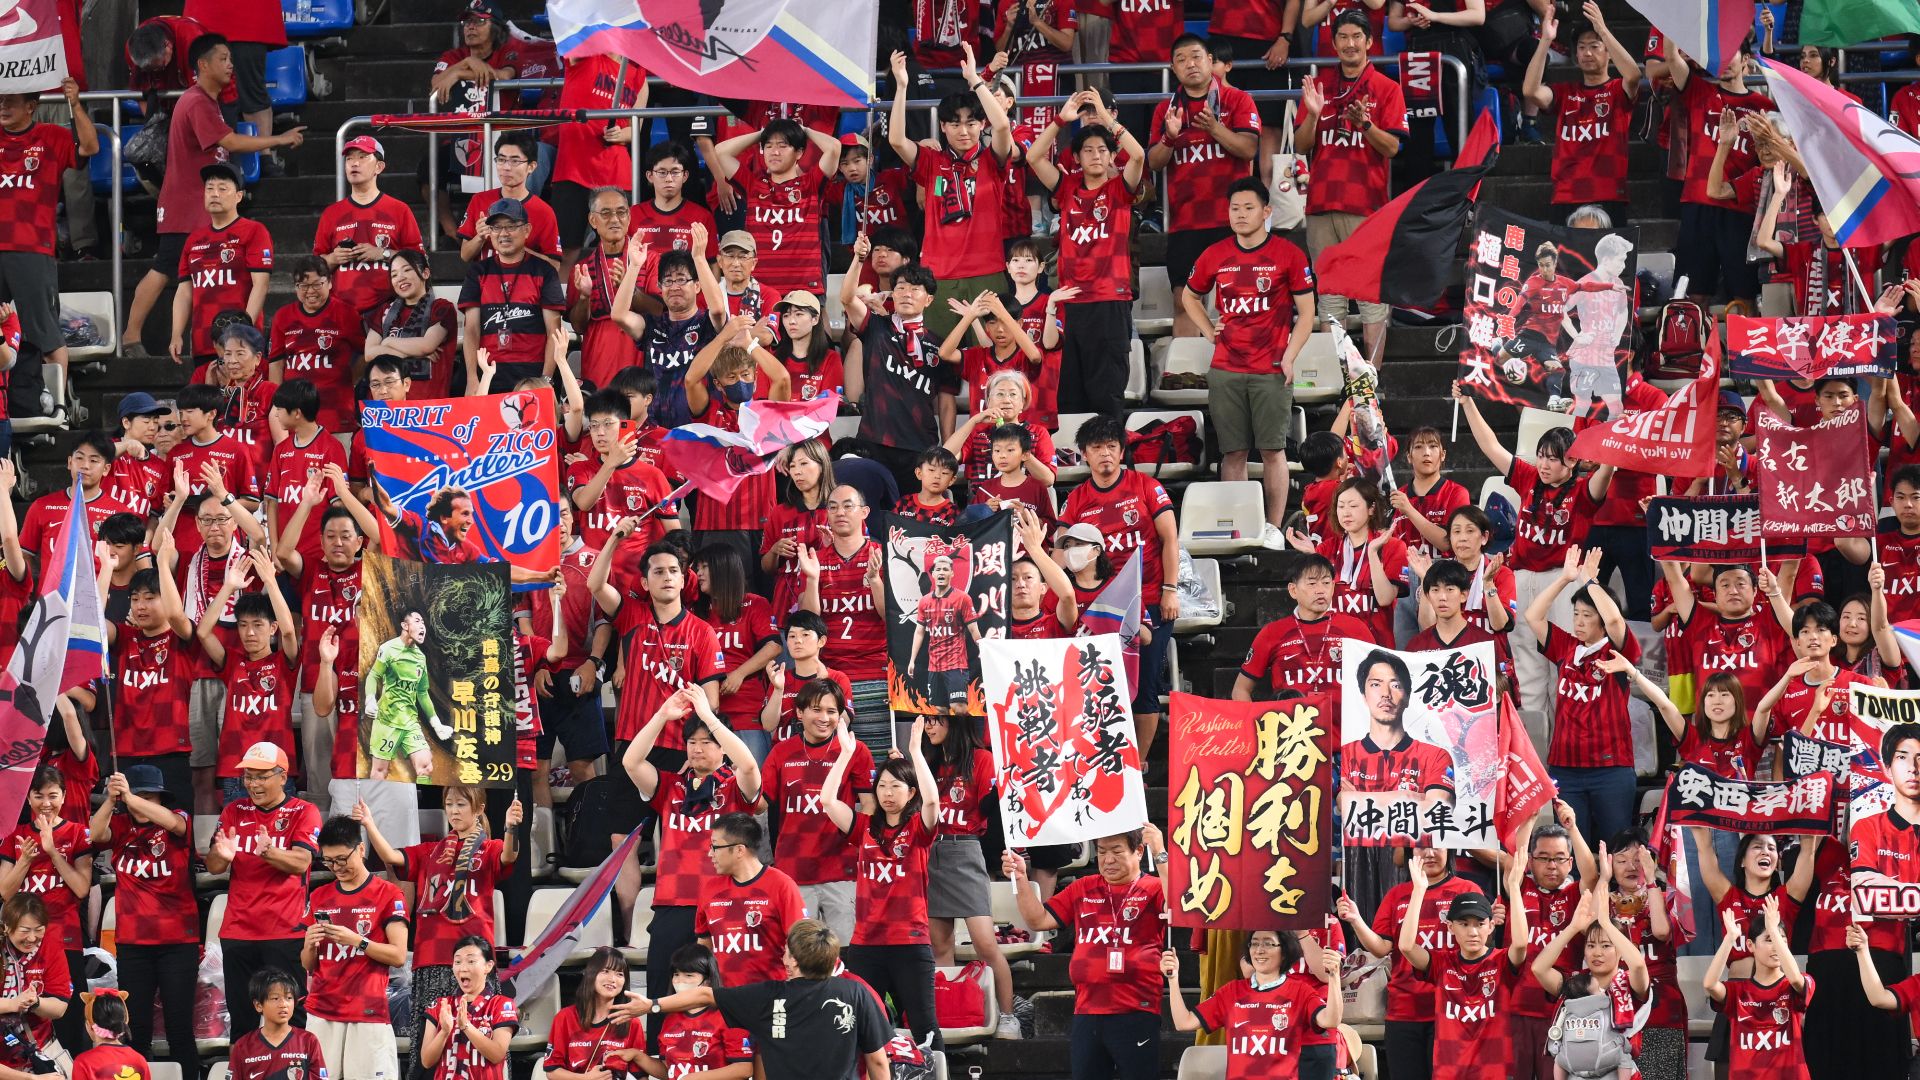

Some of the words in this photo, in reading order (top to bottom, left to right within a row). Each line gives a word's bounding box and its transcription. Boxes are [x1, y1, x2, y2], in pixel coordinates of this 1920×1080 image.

[1561, 122, 1610, 141] LIXIL
[1704, 122, 1749, 155] LIIL
[1174, 143, 1225, 164] LIXIL
[756, 205, 804, 224] LIXIL
[336, 222, 358, 232] mercari
[371, 222, 396, 230] mercari
[771, 229, 783, 251] 9
[190, 269, 237, 289] LIXIL
[1223, 297, 1270, 313] LIXIL
[1464, 231, 1502, 387] 樋口雄太
[1741, 321, 1886, 359] 三竿健斗
[286, 354, 333, 370] LIXIL
[1834, 366, 1854, 375] Kento
[1855, 365, 1878, 374] MISAO
[886, 354, 932, 395] LIXIL
[360, 404, 452, 428] SPIRIT
[452, 417, 480, 443] of
[488, 429, 555, 455] ZICO
[208, 451, 235, 460] mercari
[405, 452, 471, 463] KASHIMA
[1758, 438, 1808, 472] 名古
[391, 450, 551, 510] Antlers
[623, 485, 647, 493] mercari
[1115, 498, 1140, 508] mercari
[1776, 478, 1867, 513] 新太郎
[88, 506, 116, 515] mercari
[1081, 508, 1104, 518] mercari
[503, 498, 552, 551] 10
[1518, 520, 1565, 545] LIXIL
[1763, 519, 1800, 533] KASHIMA
[1858, 513, 1873, 530] 30
[822, 594, 873, 613] LIXIL
[842, 616, 853, 640] 2
[664, 642, 689, 650] mercari
[1702, 650, 1758, 670] LIXIL
[124, 668, 168, 690] LIXIL
[1414, 651, 1493, 710] 魂
[482, 638, 502, 746] 鹿島の守護神
[1785, 689, 1808, 699] mercari
[233, 695, 278, 715] LIXIL
[450, 680, 483, 784] 早川友基
[1176, 711, 1244, 737] Kashima
[381, 739, 394, 752] 29
[1184, 735, 1252, 765] Antlers
[784, 760, 810, 768] mercari
[1789, 736, 1851, 784] 濃野
[486, 762, 514, 781] 29
[1676, 768, 1827, 817] 安西幸輝
[1246, 704, 1329, 915] 勝利を
[1344, 799, 1495, 843] 仲間隼斗
[1172, 764, 1244, 923] 掴め
[1877, 848, 1911, 861] mercari
[117, 856, 172, 878] LIXIL
[351, 907, 377, 915] mercari
[709, 900, 733, 908] mercari
[743, 899, 769, 907] mercari
[711, 932, 763, 954] LIXIL
[1234, 1001, 1261, 1010] mercari
[1265, 1001, 1293, 1010] mercari
[1444, 999, 1497, 1023] LIXIL
[771, 998, 786, 1039] KSR
[600, 1039, 625, 1048] mercari
[1232, 1034, 1288, 1056] LIXIL
[1740, 1029, 1791, 1051] LIXIL
[280, 1051, 309, 1060] mercari
